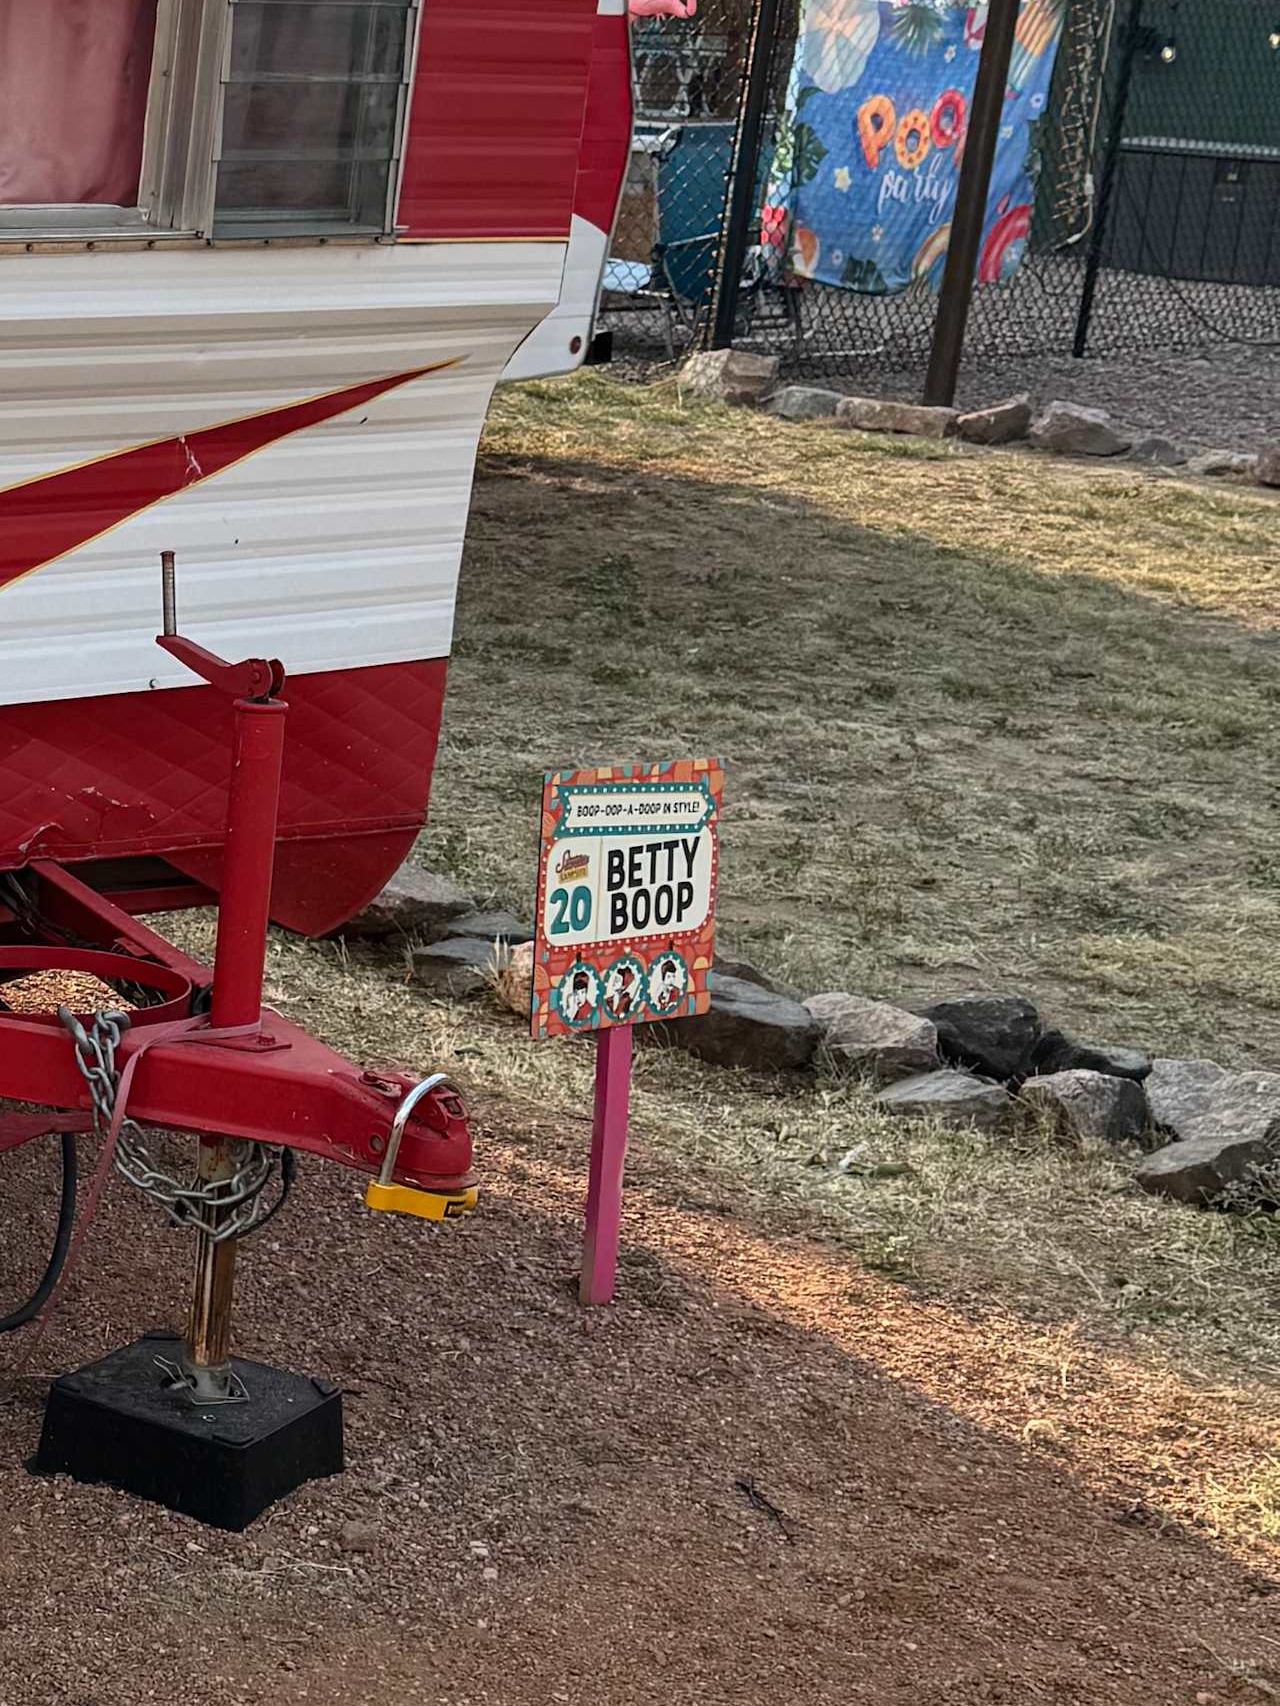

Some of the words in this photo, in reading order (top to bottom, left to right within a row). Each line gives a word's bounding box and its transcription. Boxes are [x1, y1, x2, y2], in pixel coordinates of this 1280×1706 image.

[857, 89, 968, 170] POO
[877, 153, 954, 224] party
[663, 803, 671, 814] IN
[673, 801, 700, 814] STYLE!
[607, 836, 701, 892] BETTY
[550, 885, 592, 935] 20
[610, 881, 694, 935] BOOP
